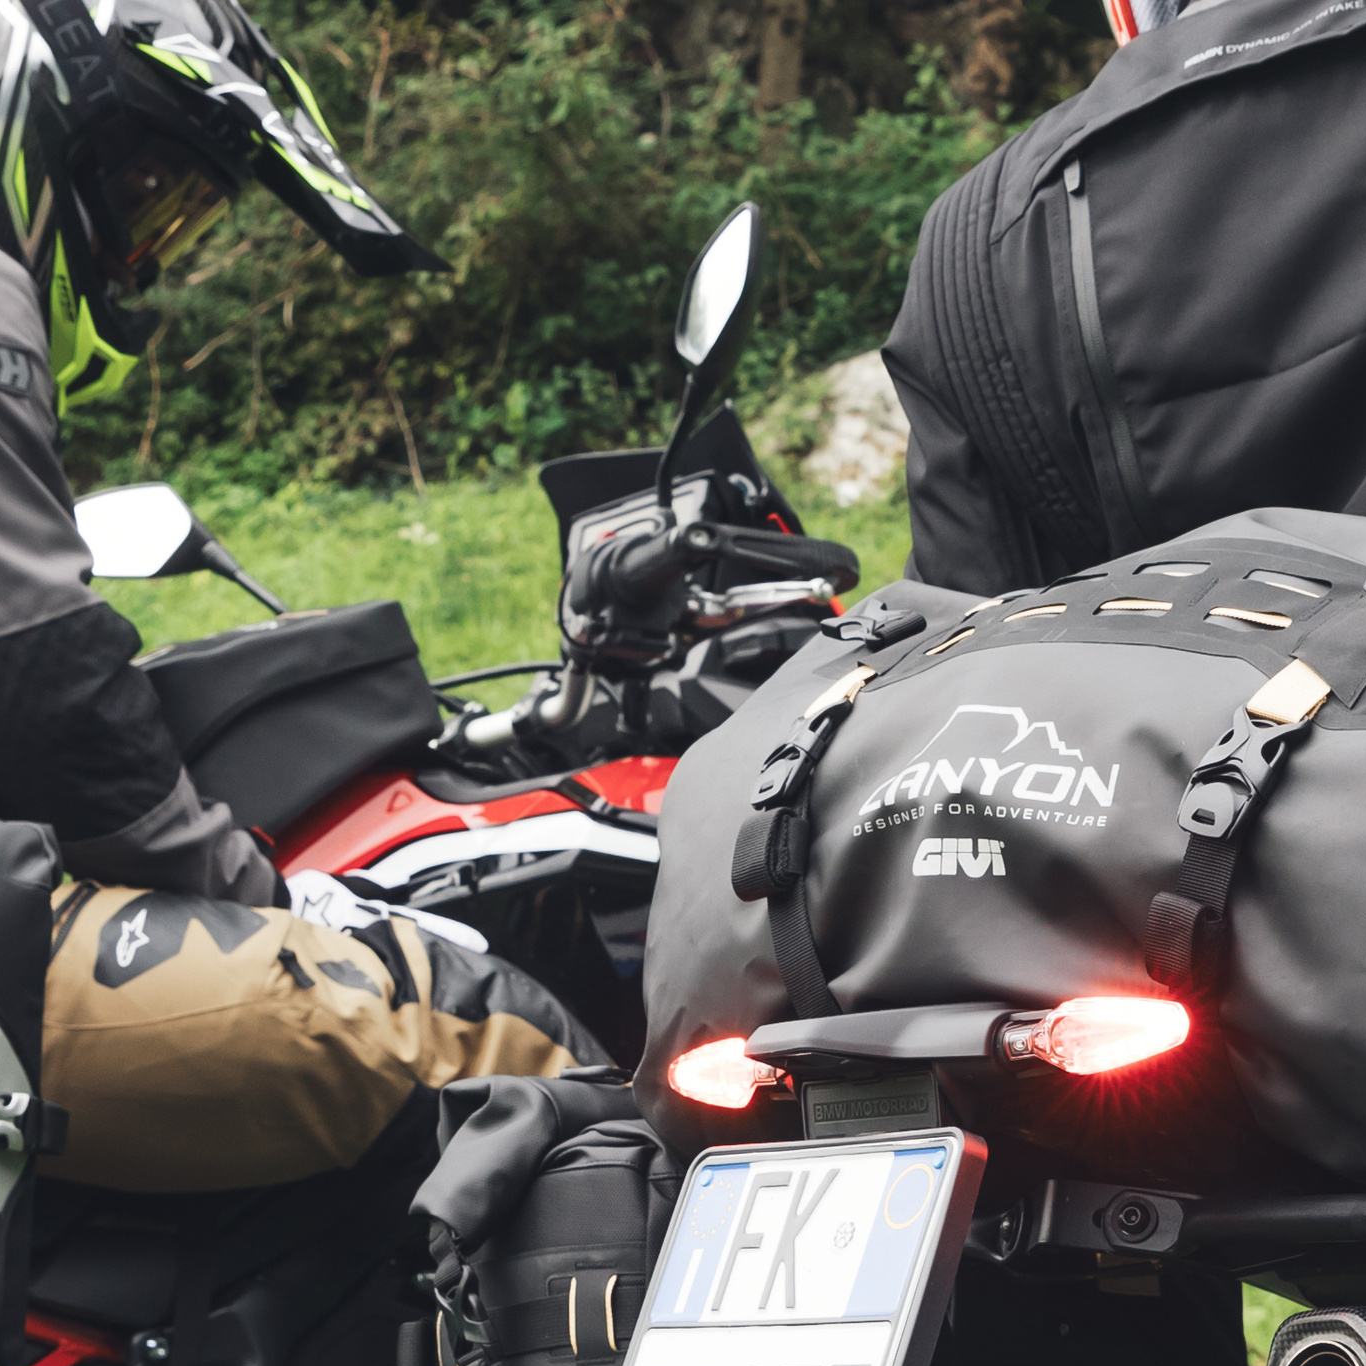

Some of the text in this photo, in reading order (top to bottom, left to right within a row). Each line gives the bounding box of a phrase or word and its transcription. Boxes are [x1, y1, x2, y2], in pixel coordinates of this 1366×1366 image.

[1226, 33, 1290, 54] DYNAMIC
[858, 757, 1121, 816] CANYON
[853, 803, 1108, 837] DESIGNED FOR ADVENTURE
[912, 837, 1006, 879] GIVI
[815, 1096, 928, 1121] BMW MOTORRAD
[710, 1168, 841, 1312] FK
